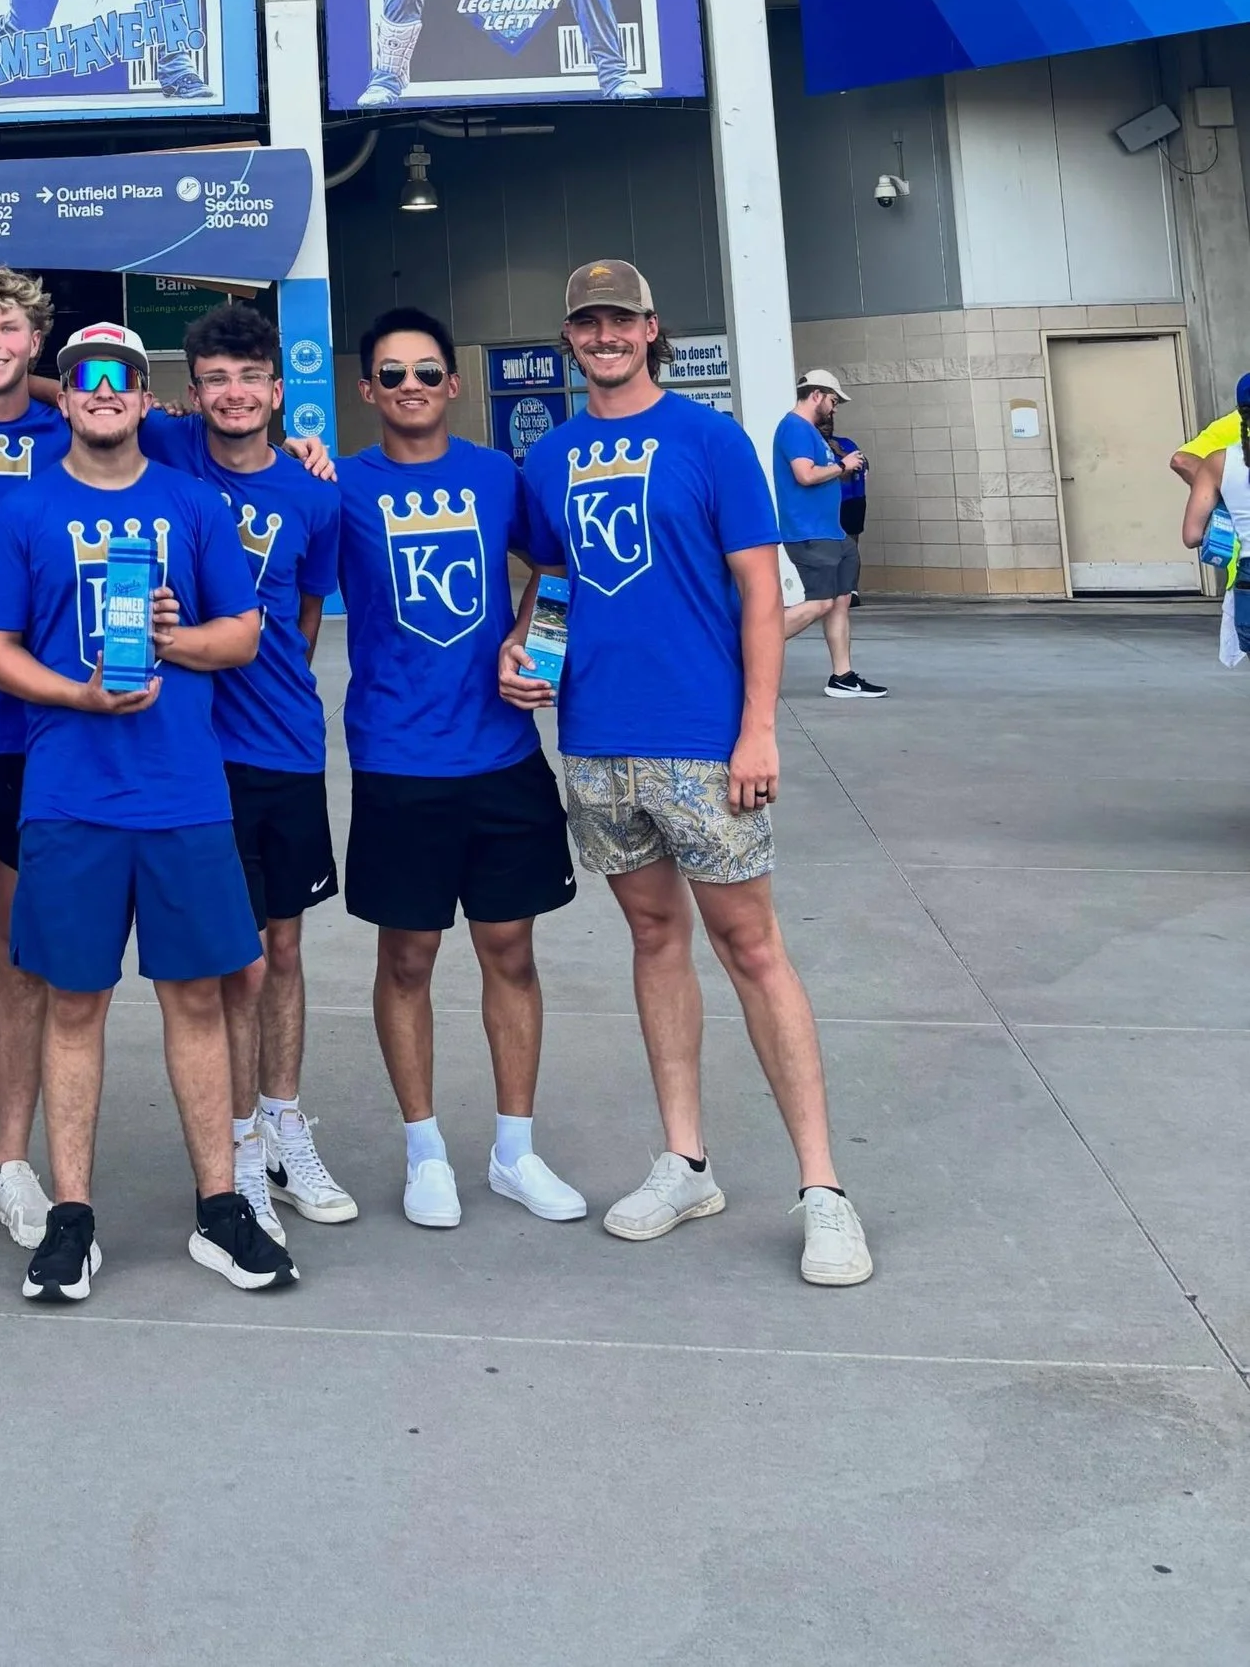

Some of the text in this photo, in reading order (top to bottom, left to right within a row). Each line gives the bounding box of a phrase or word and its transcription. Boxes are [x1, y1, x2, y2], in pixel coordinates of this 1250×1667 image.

[483, 13, 538, 30] LEFTY
[57, 184, 163, 202] Outfield Plaza
[205, 180, 250, 198] Up To
[57, 203, 104, 218] Rivals
[205, 196, 274, 212] Sections
[206, 212, 269, 229] 300-400
[133, 305, 176, 313] Challenge
[689, 344, 722, 360] doesn't
[503, 357, 554, 380] SUNDAY 4-PACK
[670, 360, 728, 377] like free stuff
[517, 402, 544, 414] 4 tickets
[515, 415, 548, 430] 4 hot dogs
[573, 491, 641, 563] KC
[399, 545, 477, 616] KC
[109, 597, 145, 612] ARMED
[108, 612, 145, 627] FORCES
[108, 626, 143, 634] NIGHT
